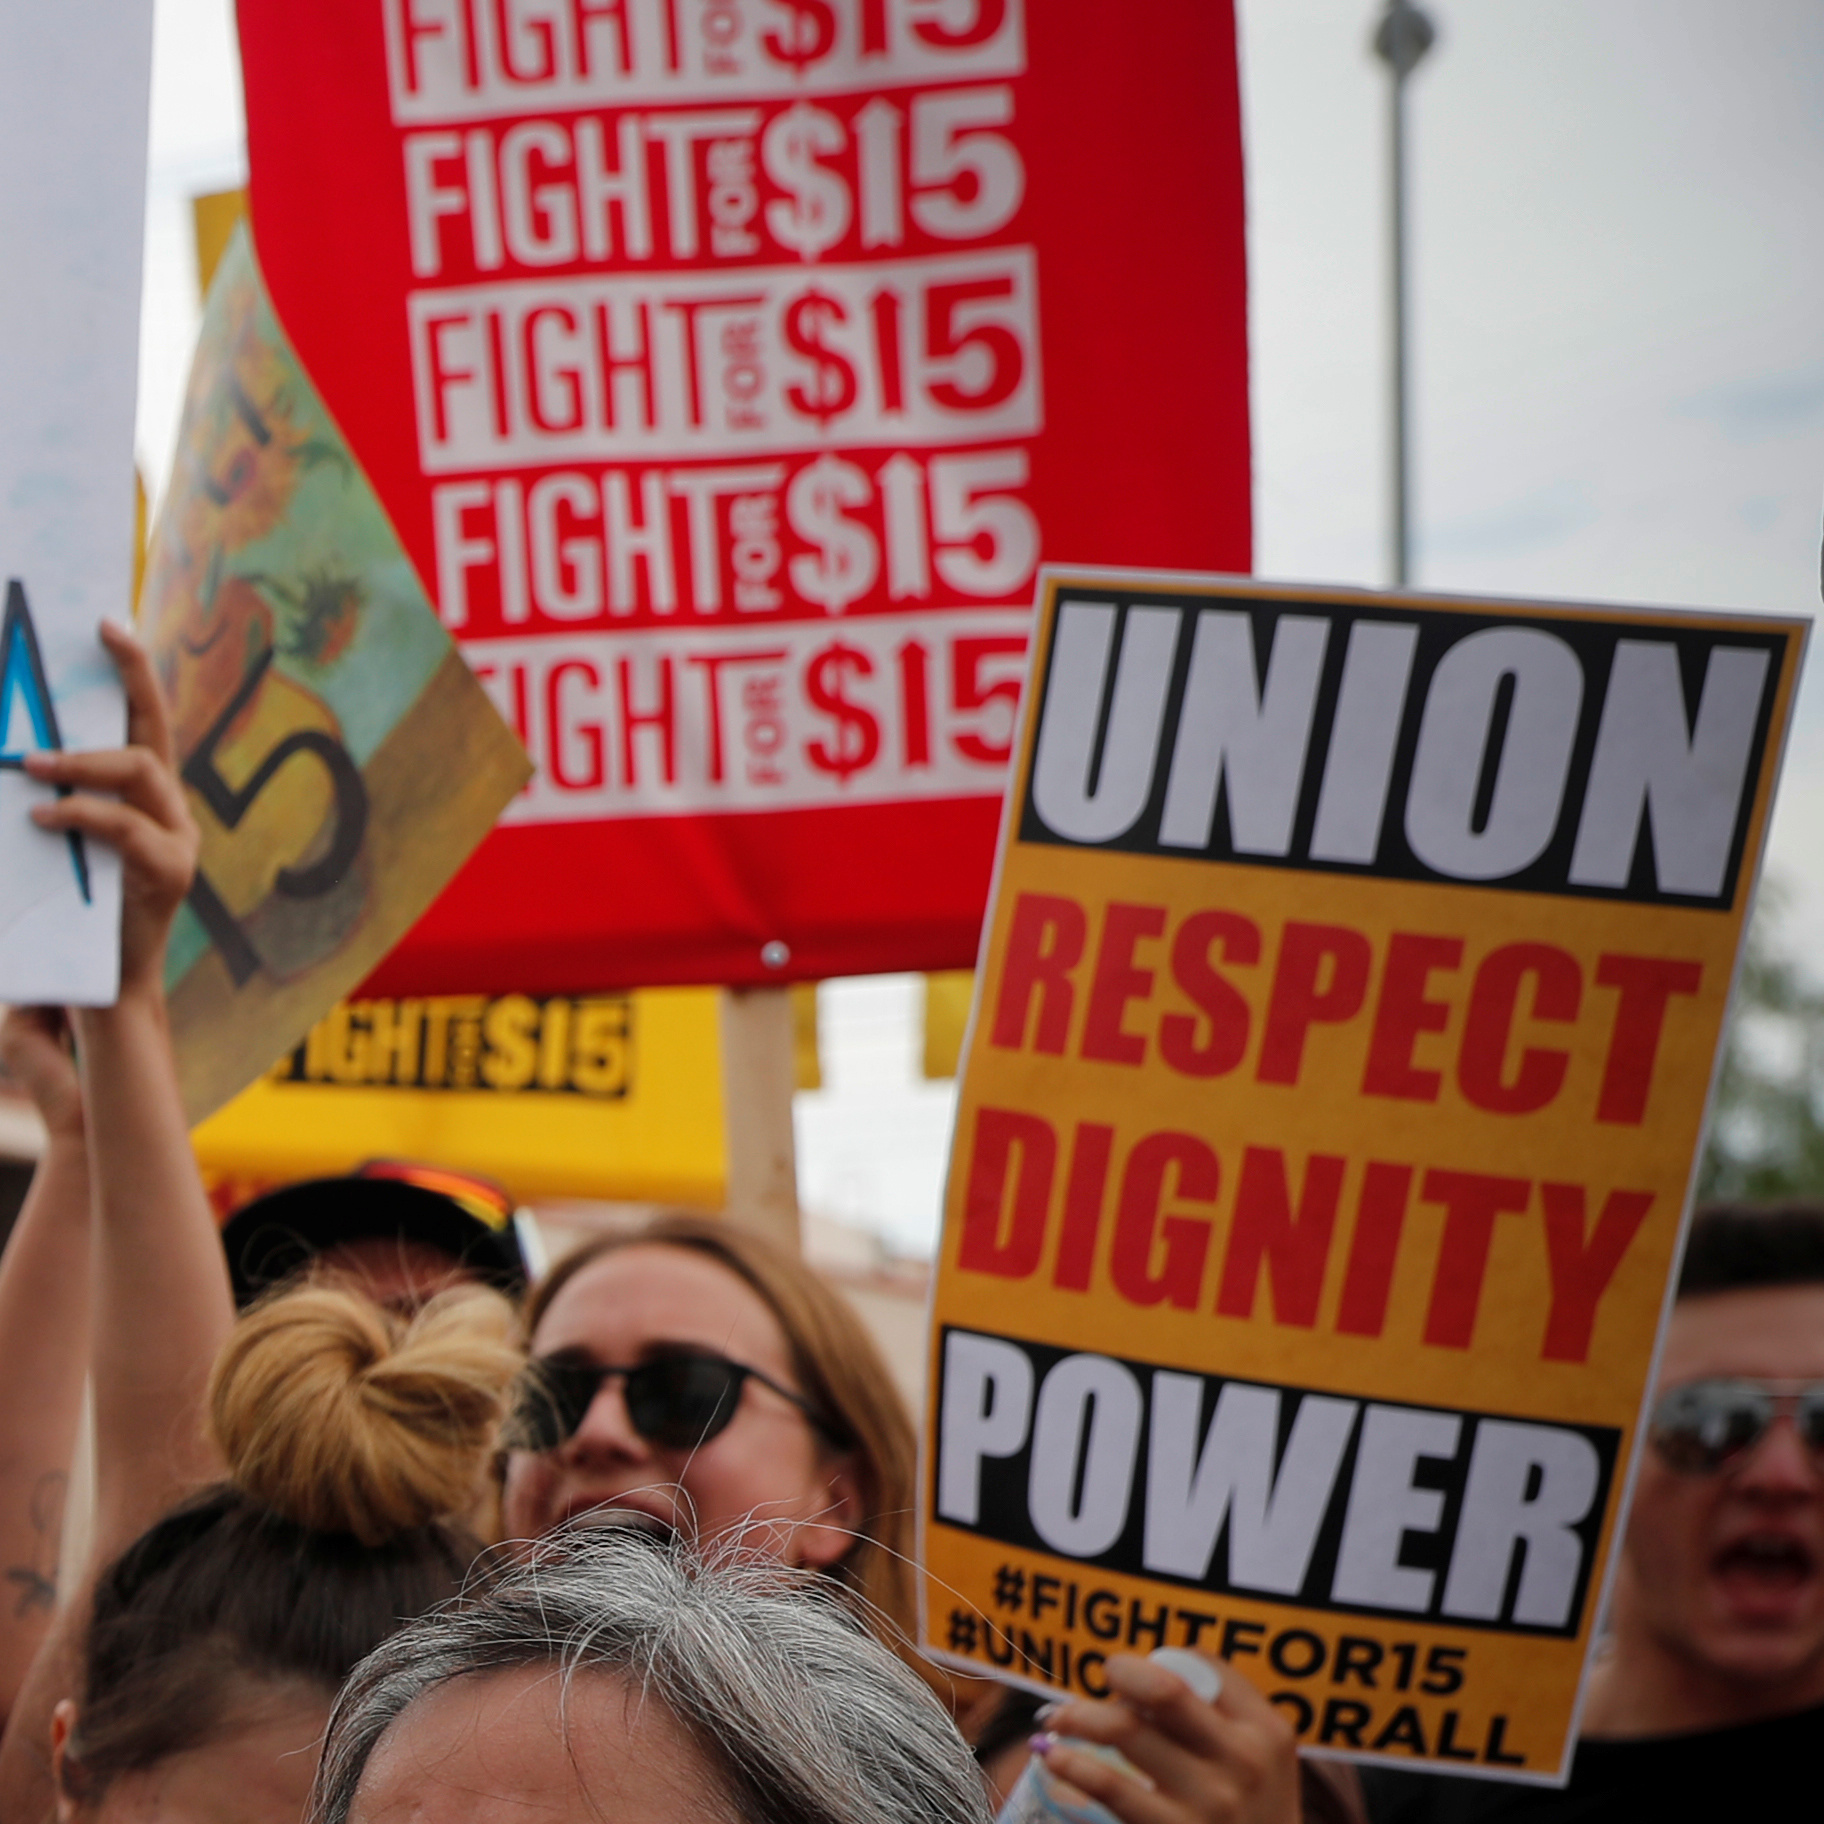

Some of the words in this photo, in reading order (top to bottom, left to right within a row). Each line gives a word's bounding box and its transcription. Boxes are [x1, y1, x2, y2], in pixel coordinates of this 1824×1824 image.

[392, 0, 682, 93] FIGHT
[403, 108, 760, 277] FIGHT
[707, 138, 760, 258] FOR
[761, 84, 1027, 262] $15
[426, 291, 770, 444] FIGHT
[722, 316, 768, 431] FOR
[782, 275, 1026, 434] $15
[432, 464, 786, 629] FIGHT
[730, 495, 781, 611] FOR
[786, 447, 1041, 614] $15
[480, 650, 790, 796] IGHT
[745, 673, 788, 785] FOR
[805, 632, 1028, 785] $15
[1031, 600, 1772, 897] UNION
[269, 1000, 455, 1083] IGHT
[988, 890, 1703, 1128] RESPECT
[957, 1105, 1657, 1365] DIGNITY
[939, 1330, 1604, 1630] POWER
[993, 1564, 1468, 1696] #FIGHTFOR15
